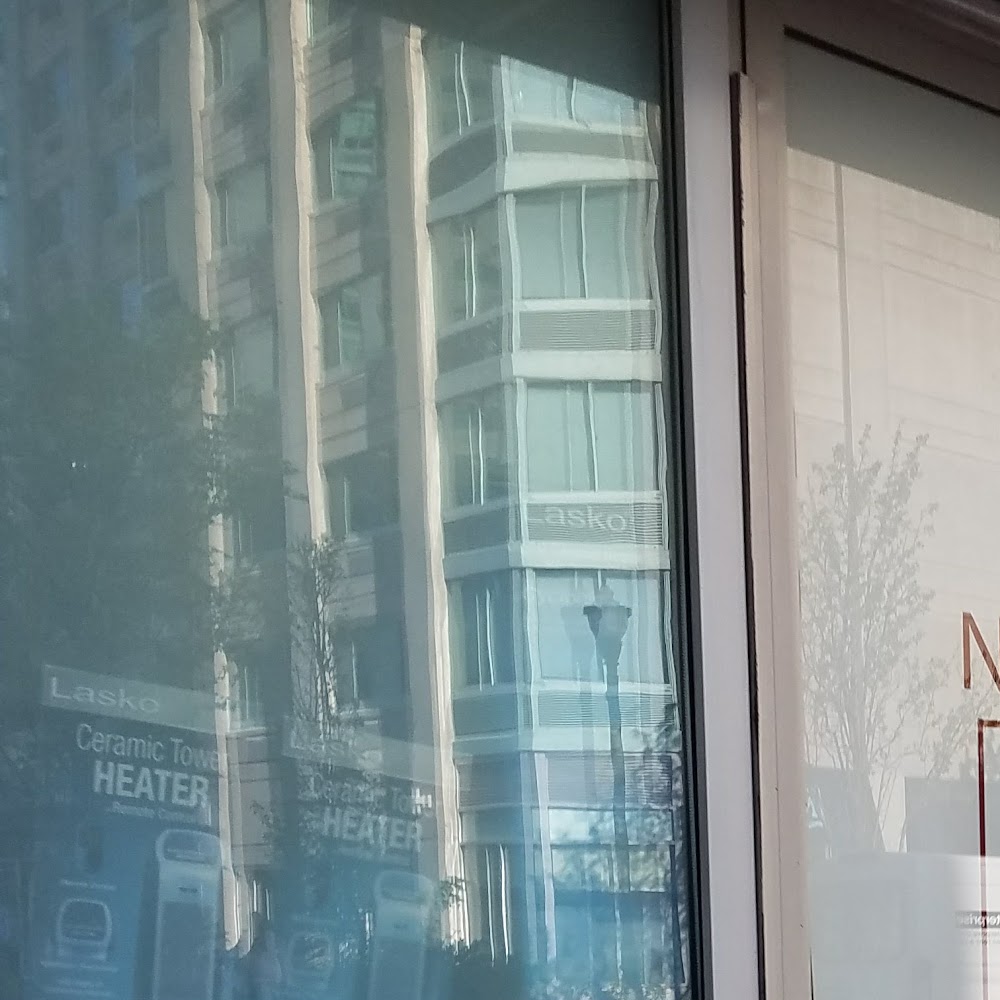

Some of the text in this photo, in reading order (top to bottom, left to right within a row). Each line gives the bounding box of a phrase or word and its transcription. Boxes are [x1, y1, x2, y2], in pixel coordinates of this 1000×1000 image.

[49, 675, 161, 714] Lasko
[75, 722, 225, 772] Ceramic Towe
[92, 759, 211, 808] HEATER
